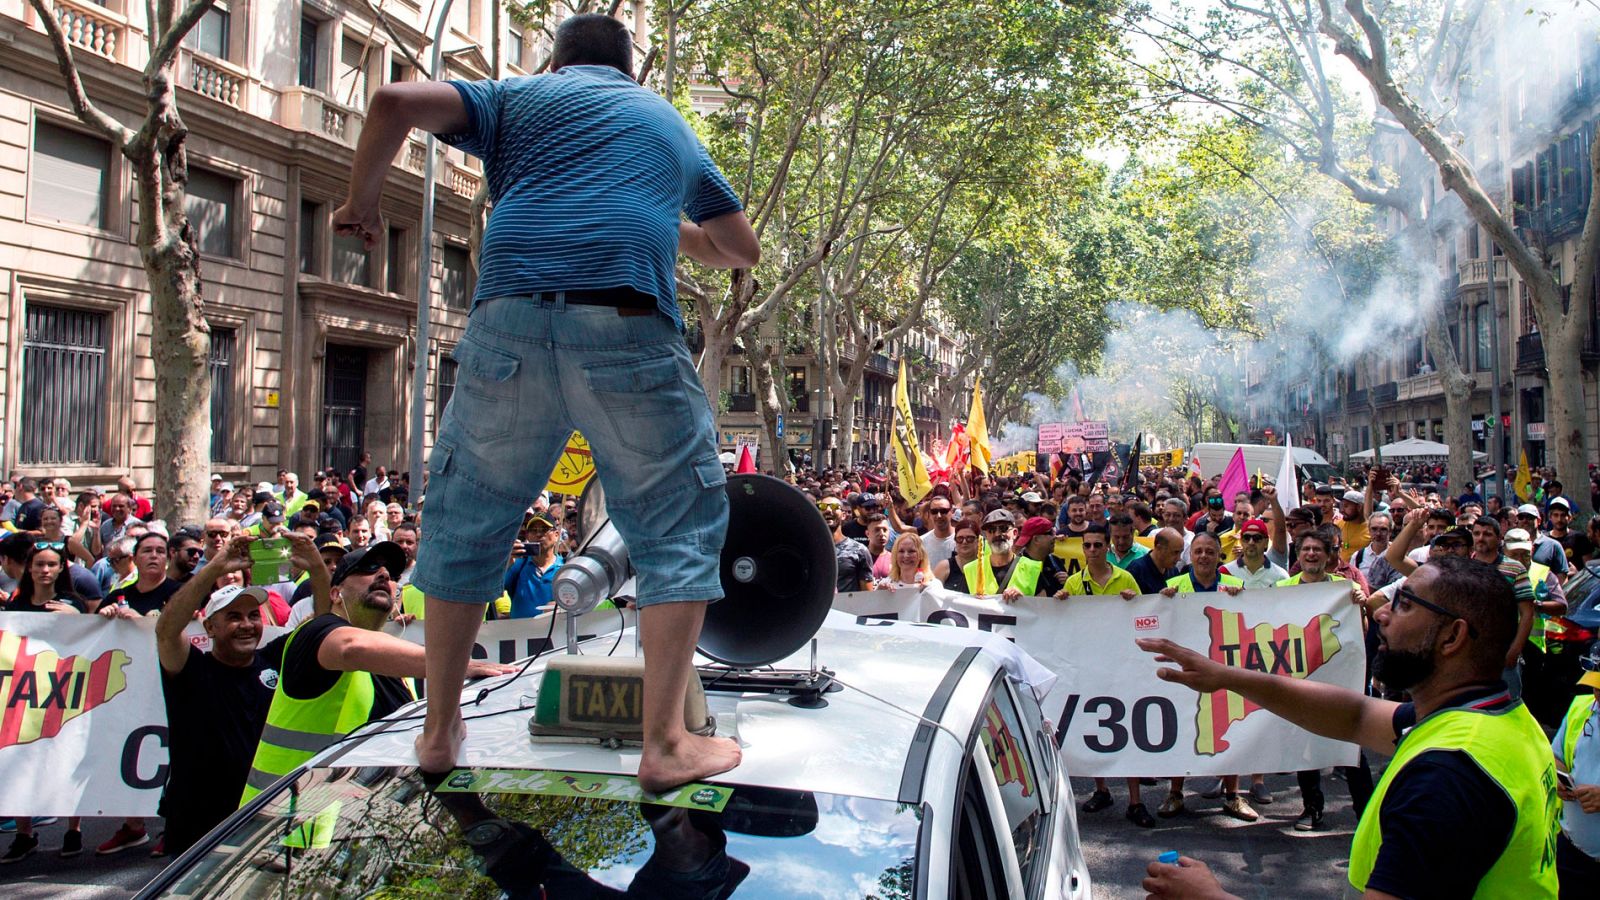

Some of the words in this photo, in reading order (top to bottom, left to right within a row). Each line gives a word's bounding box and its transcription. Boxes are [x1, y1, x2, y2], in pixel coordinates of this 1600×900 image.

[1219, 638, 1304, 675] TAXI
[573, 680, 641, 719] TAXI
[482, 772, 550, 792] Tele
